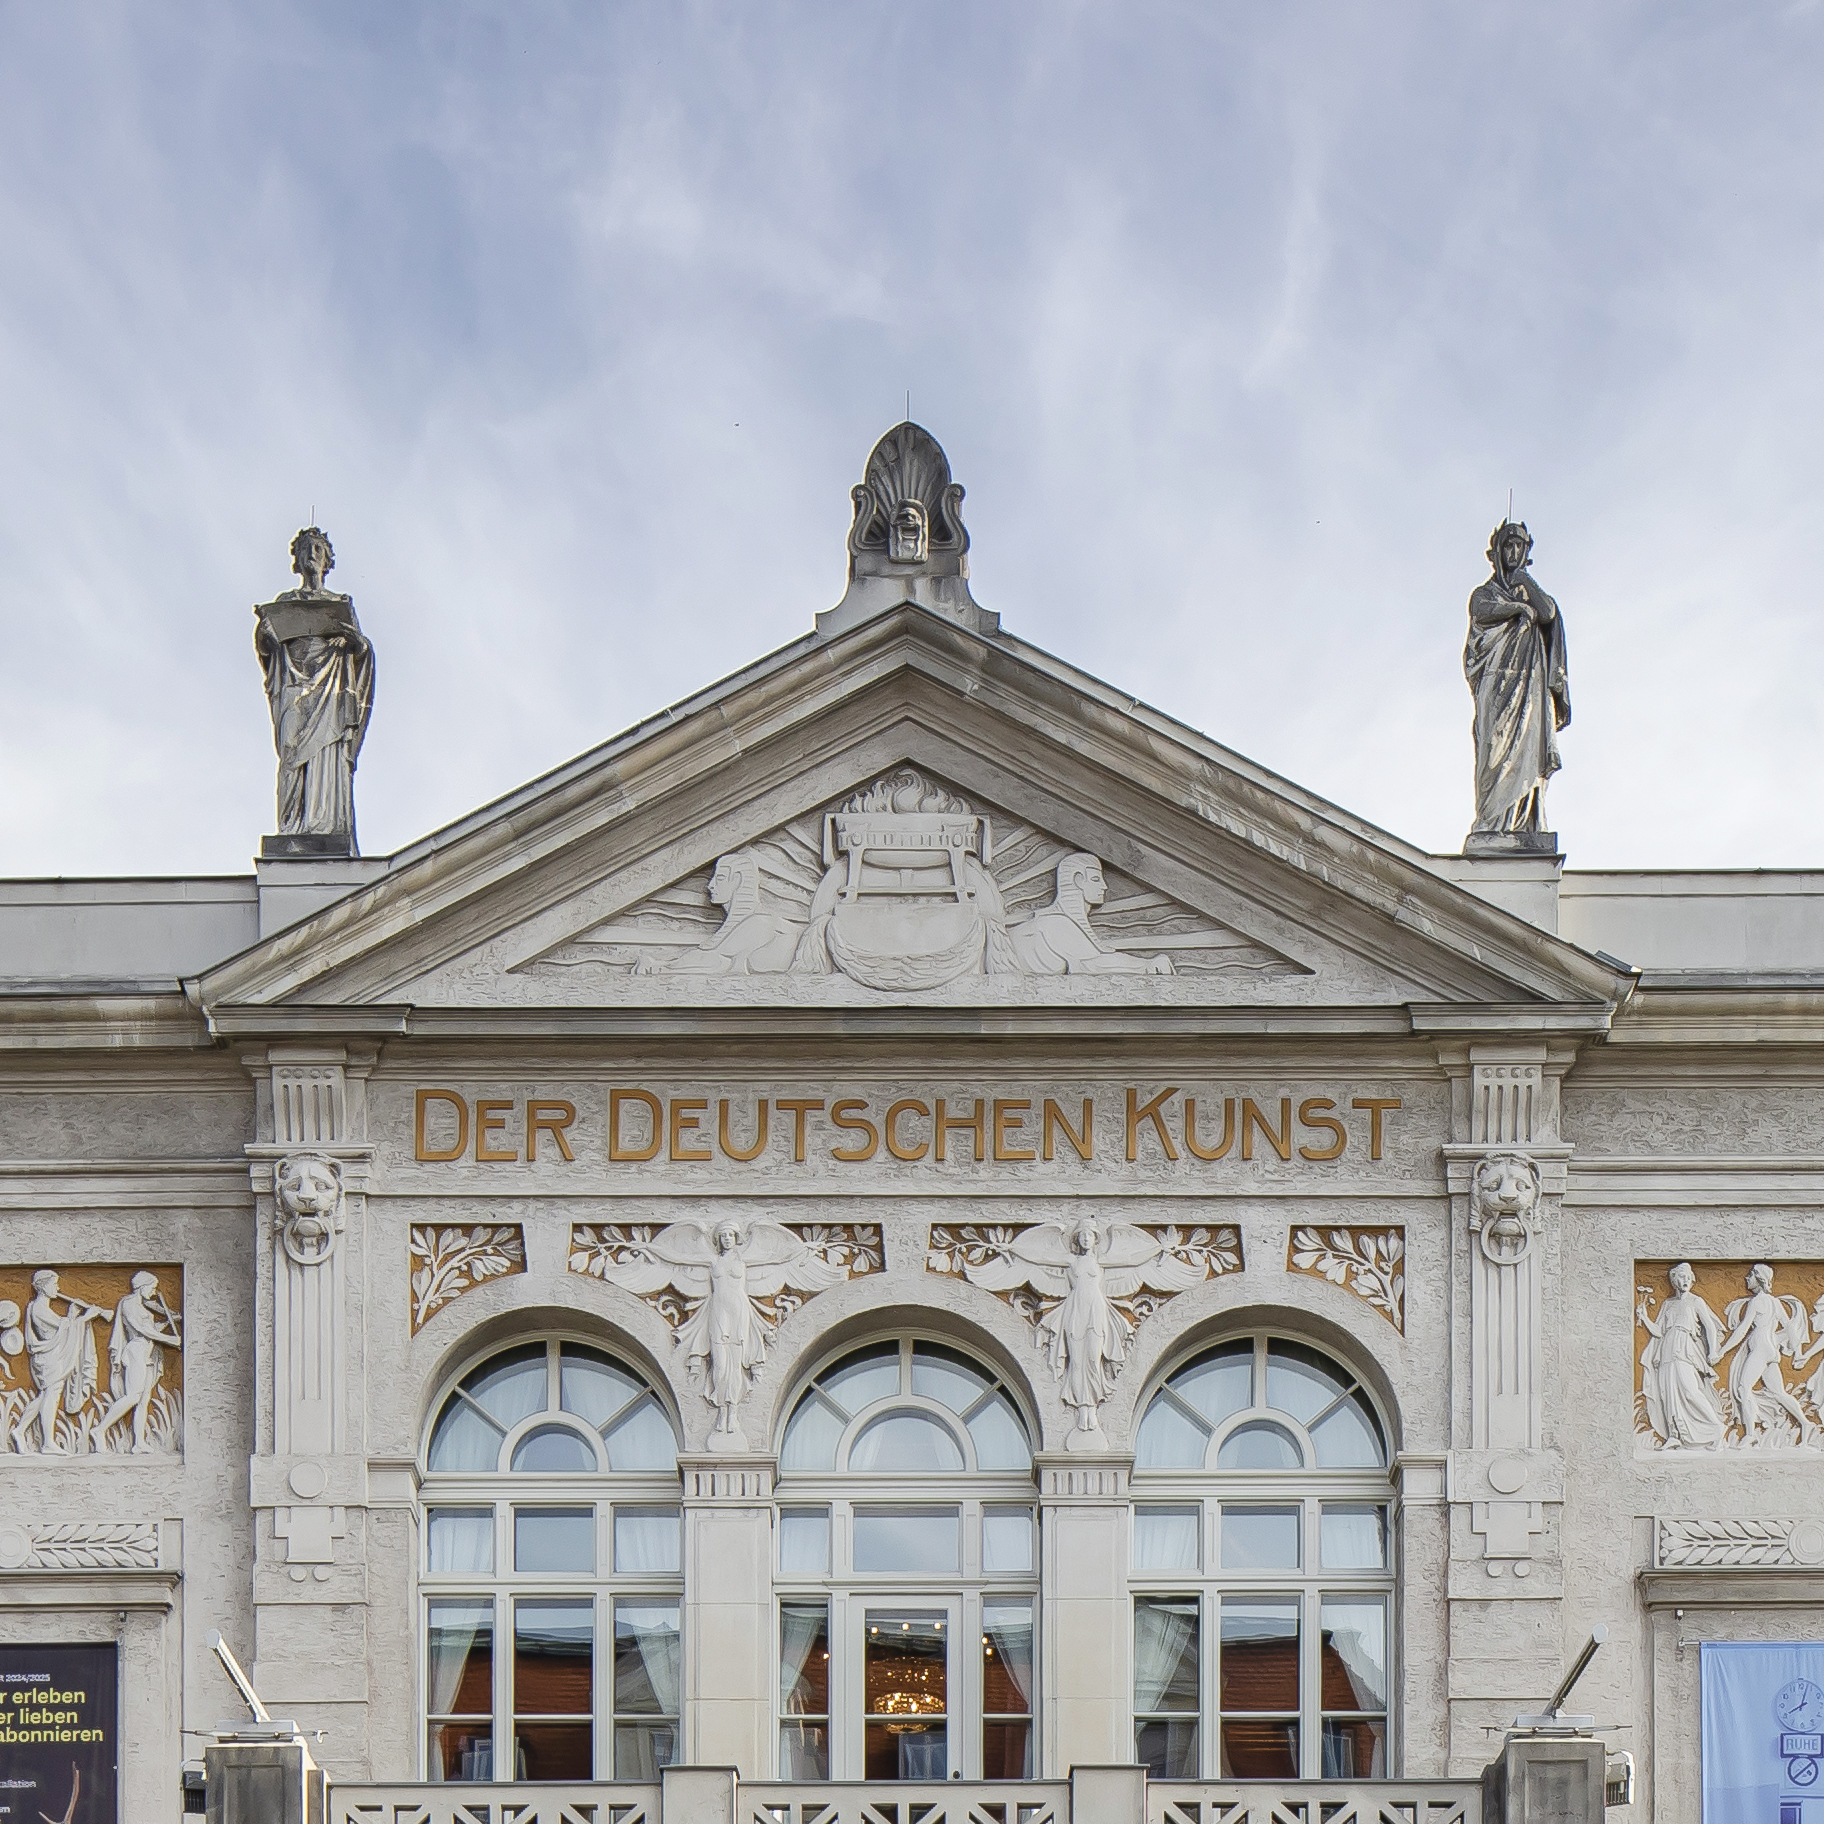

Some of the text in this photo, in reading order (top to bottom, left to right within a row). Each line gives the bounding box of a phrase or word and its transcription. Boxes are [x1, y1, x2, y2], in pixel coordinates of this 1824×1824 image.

[12, 1687, 86, 1704] erleben
[19, 1707, 78, 1724] lieben
[1786, 1738, 1818, 1751] RUHE
